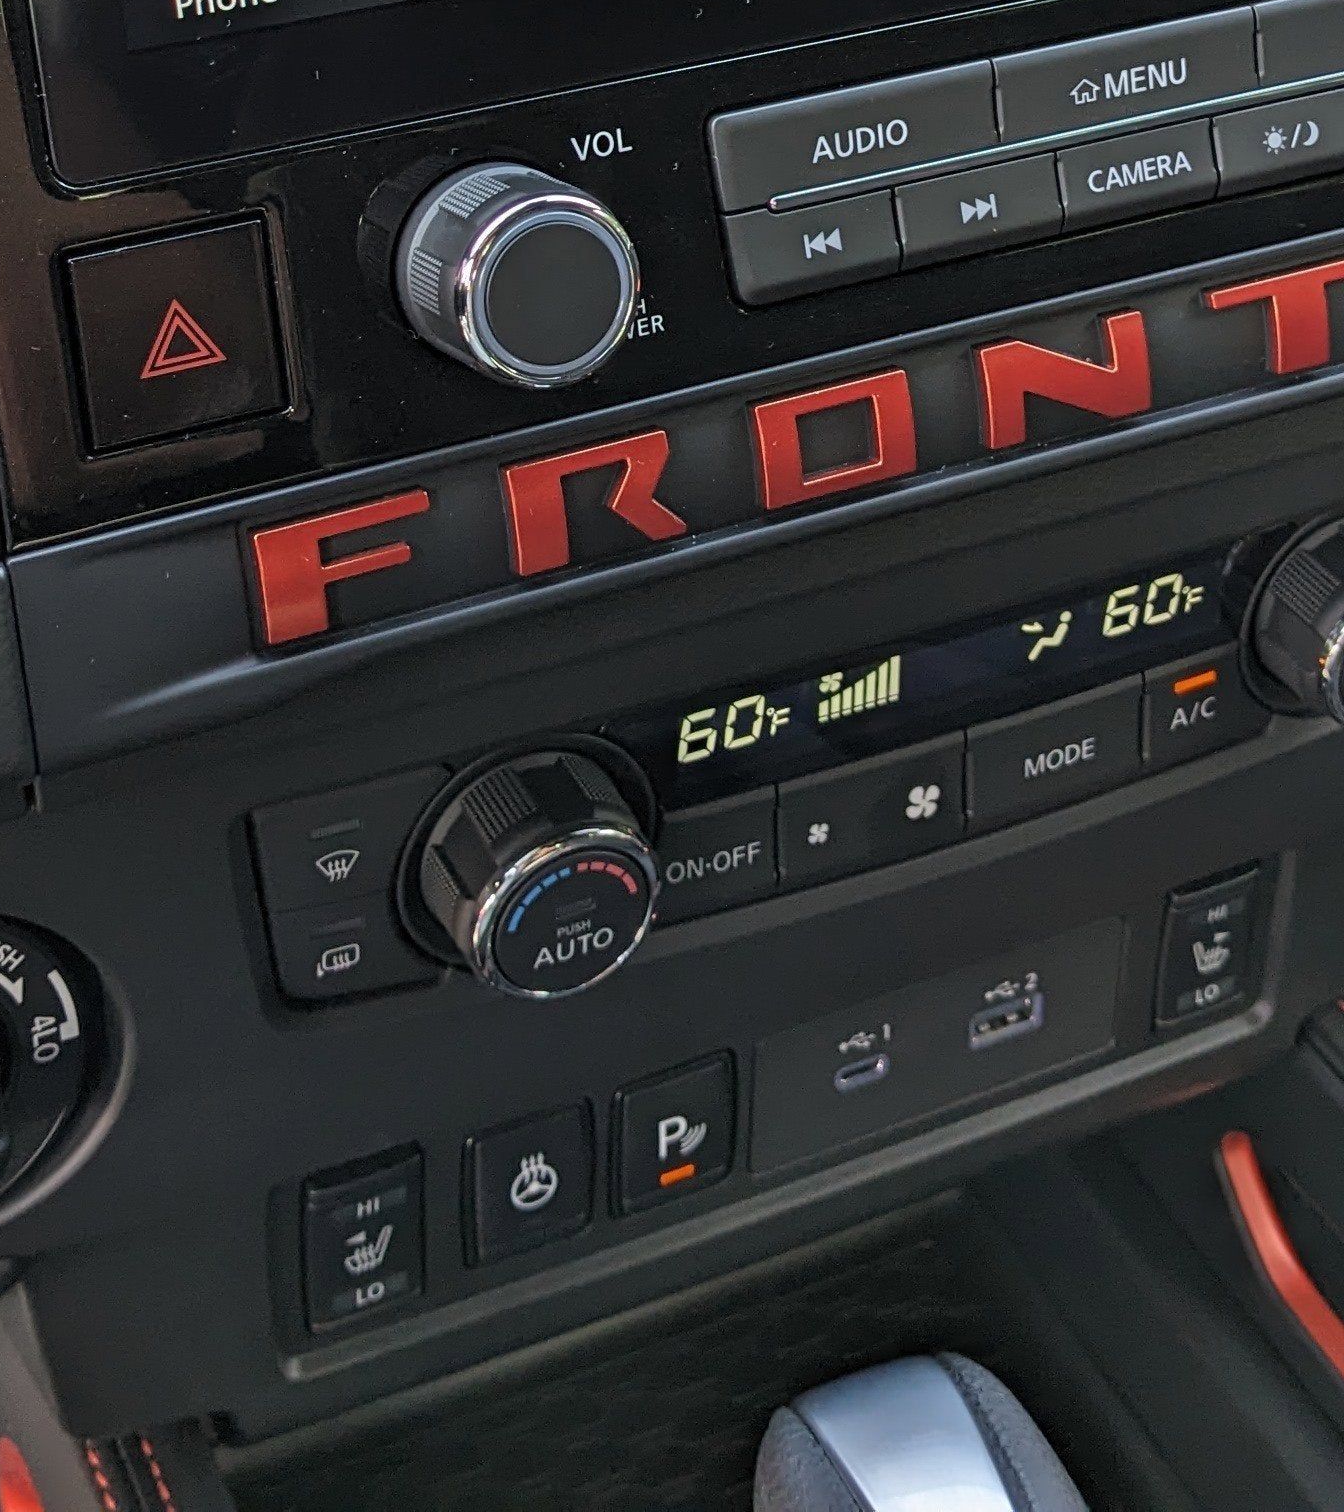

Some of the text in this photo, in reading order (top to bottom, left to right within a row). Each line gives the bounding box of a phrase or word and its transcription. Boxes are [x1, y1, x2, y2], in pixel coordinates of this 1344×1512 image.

[1103, 59, 1189, 101] MENU
[570, 128, 633, 162] VOL
[811, 119, 909, 165] AUDIO
[1087, 151, 1192, 193] CAMERA
[1169, 696, 1218, 732] A/C
[1023, 737, 1096, 778] MODE
[557, 918, 592, 938] PUSH
[532, 926, 615, 970] AUTO
[1024, 972, 1038, 991] 2
[1195, 983, 1220, 1005] LO
[30, 1014, 60, 1064] 4LO
[658, 1115, 686, 1159] P
[357, 1197, 380, 1219] HI
[356, 1281, 386, 1306] LO
